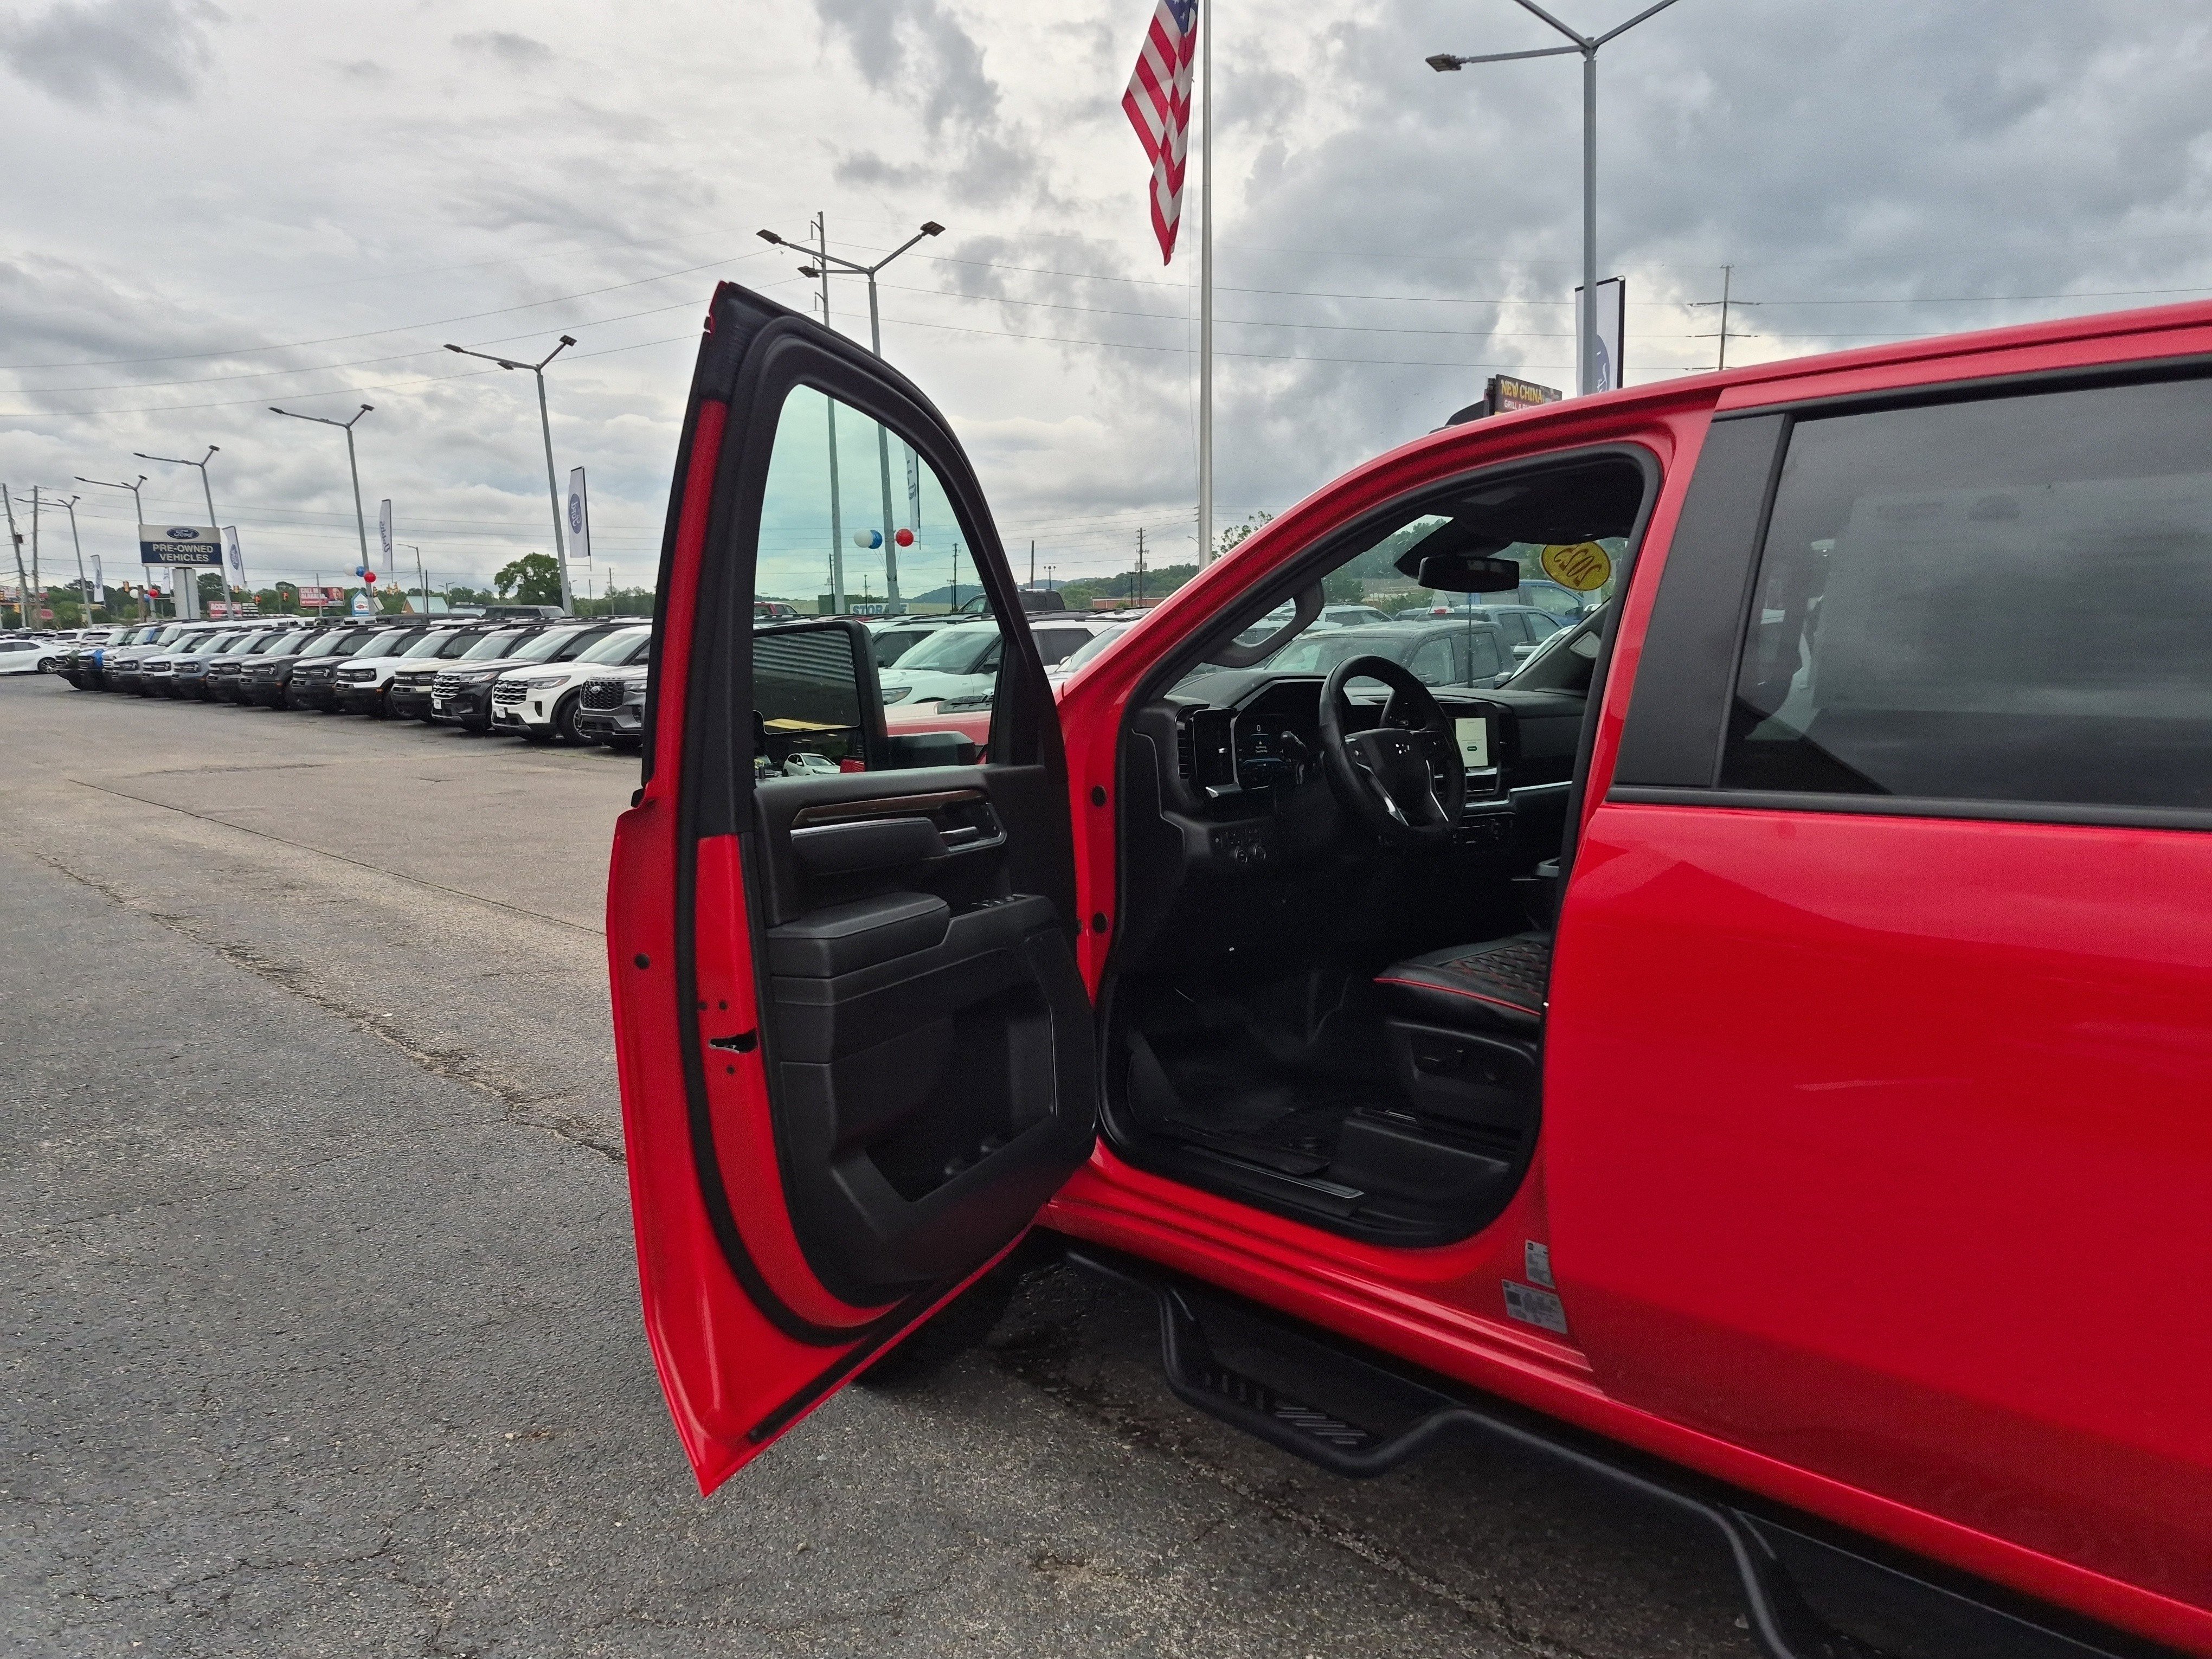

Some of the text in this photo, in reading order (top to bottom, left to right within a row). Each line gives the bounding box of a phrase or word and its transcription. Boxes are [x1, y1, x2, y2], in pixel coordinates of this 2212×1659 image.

[1501, 380, 1543, 403] NEW CHINA
[1504, 400, 1517, 410] GRILL
[152, 544, 214, 553] PRE-OWNED
[159, 554, 209, 562] VEHICLES
[853, 603, 907, 614] STORAE
